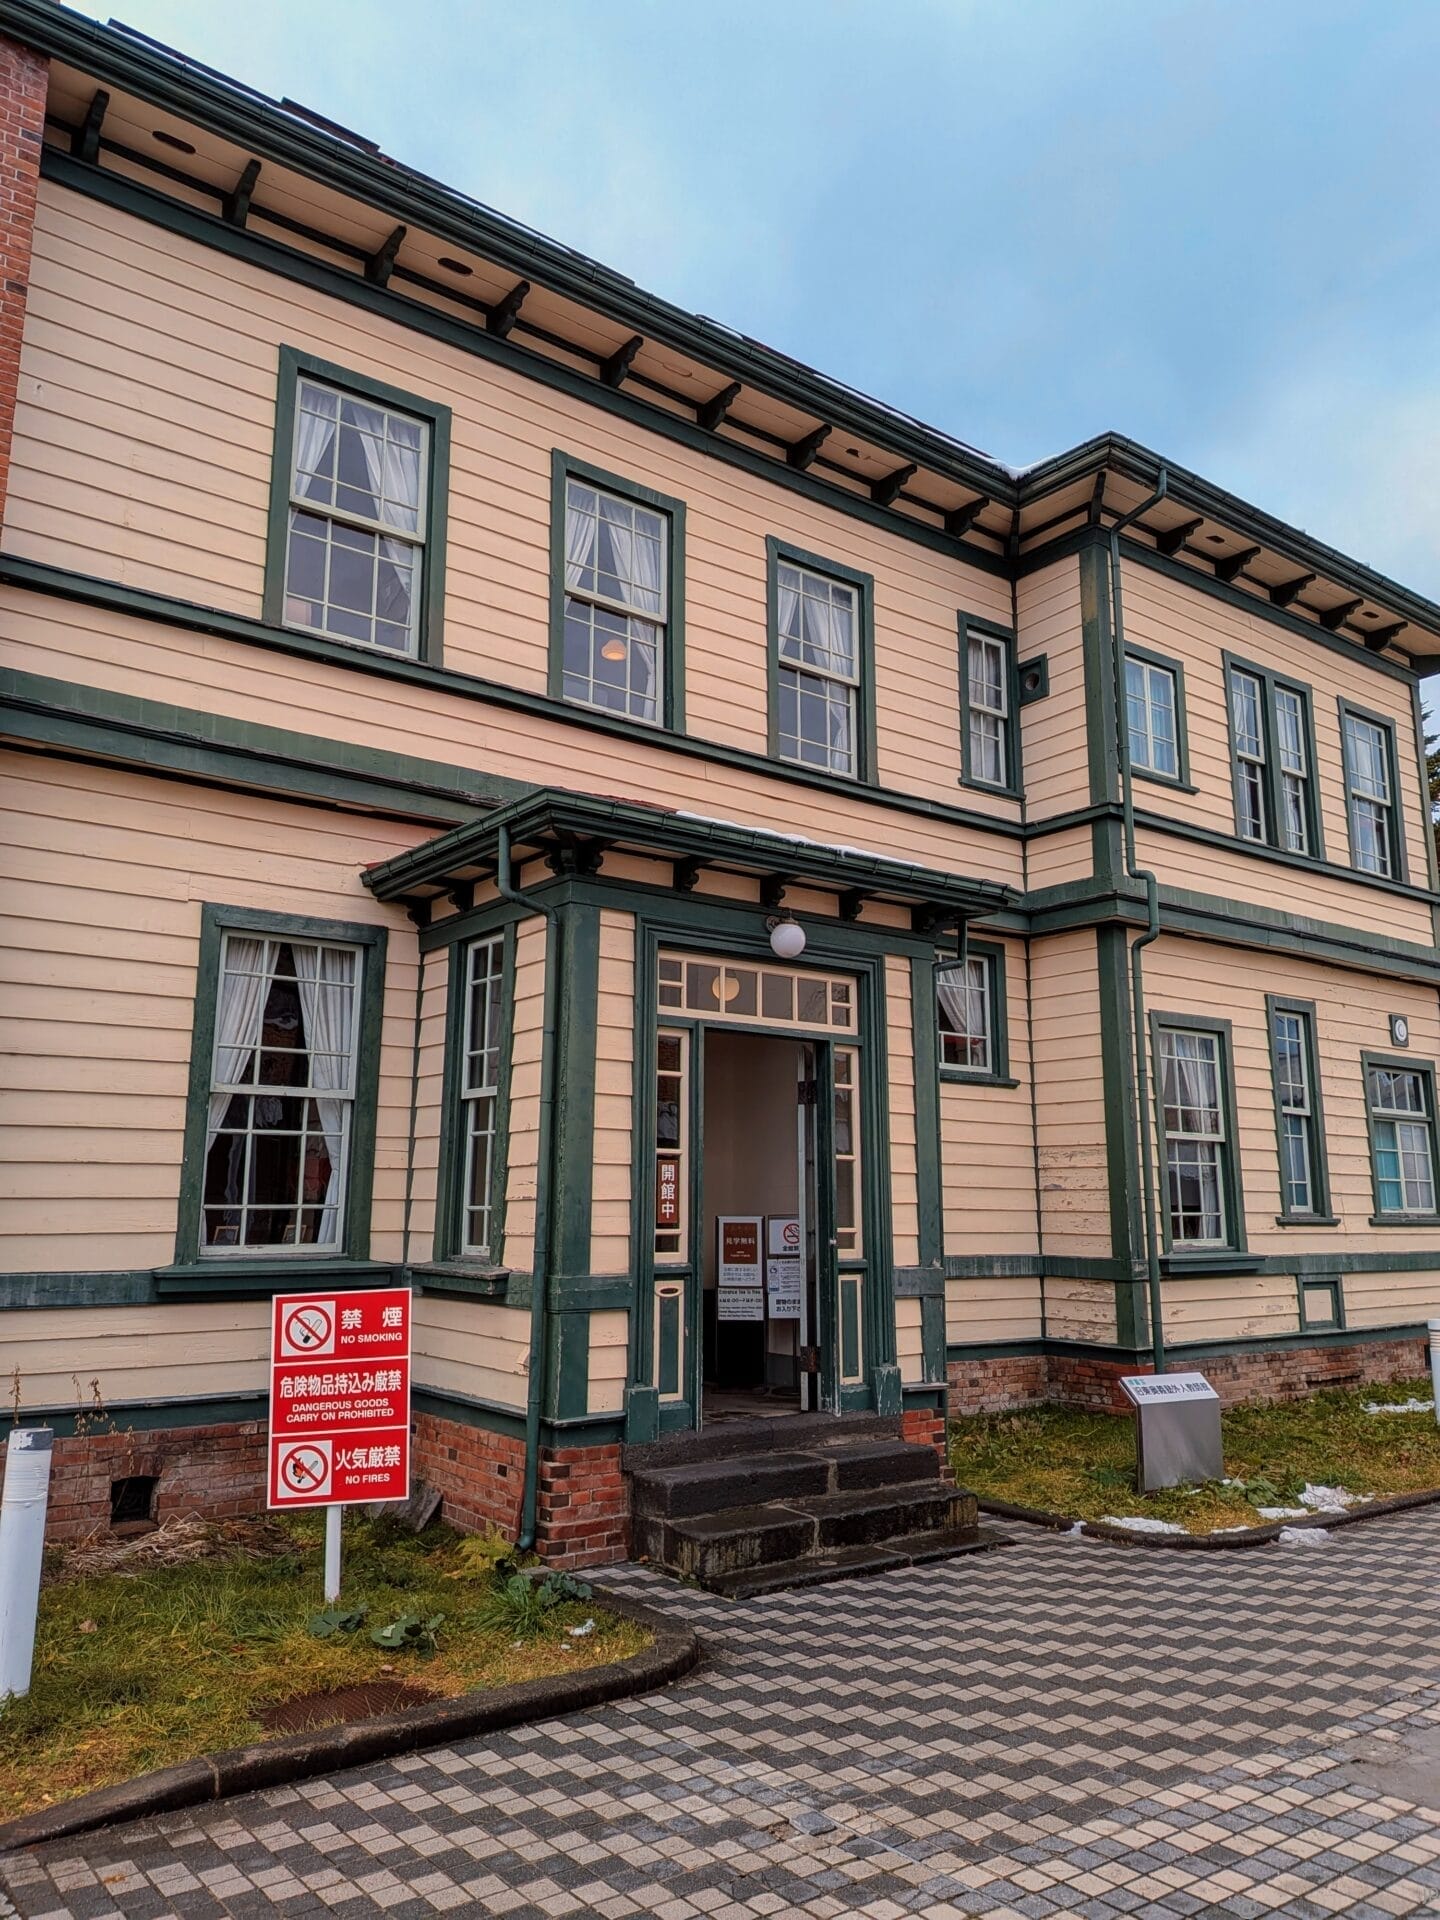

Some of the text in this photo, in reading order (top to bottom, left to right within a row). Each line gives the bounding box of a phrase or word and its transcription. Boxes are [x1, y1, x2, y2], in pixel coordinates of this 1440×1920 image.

[661, 1164, 675, 1219] 開館中
[340, 1332, 403, 1345] NO SMOKING
[279, 1369, 402, 1399] 危険物品持込み厳禁
[292, 1398, 389, 1413] DANGEROUS GOODS
[286, 1408, 395, 1423] CARRY ON PROHIBITED
[335, 1445, 401, 1471] 火気厳禁
[345, 1473, 391, 1485] NO FIRES
